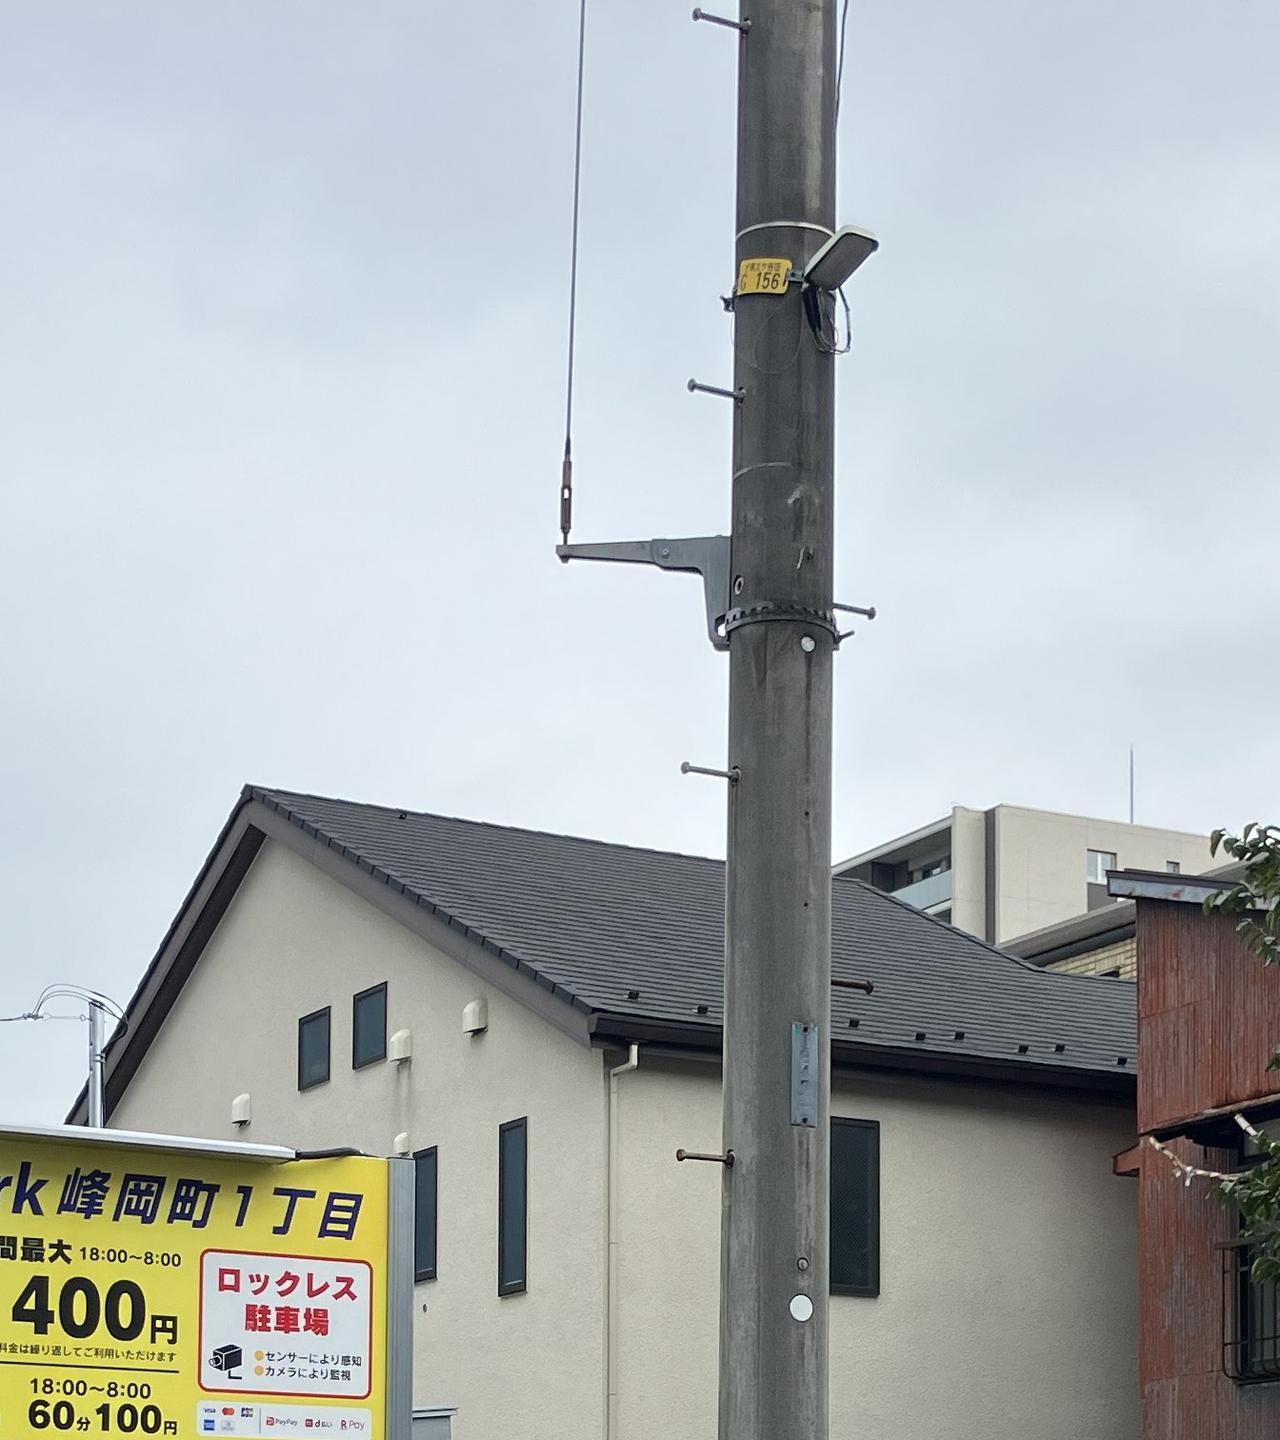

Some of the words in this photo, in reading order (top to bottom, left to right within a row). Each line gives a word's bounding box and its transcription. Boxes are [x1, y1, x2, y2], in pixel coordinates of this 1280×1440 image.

[56, 1167, 365, 1240] 峰岡町1丁目
[218, 1268, 357, 1301] ロックレス
[11, 1275, 178, 1345] 400円
[244, 1304, 330, 1336] 駐車場
[265, 1351, 362, 1367] センサーにより感知
[265, 1366, 351, 1381] カメラにより監視
[28, 1399, 178, 1435] 60分100円
